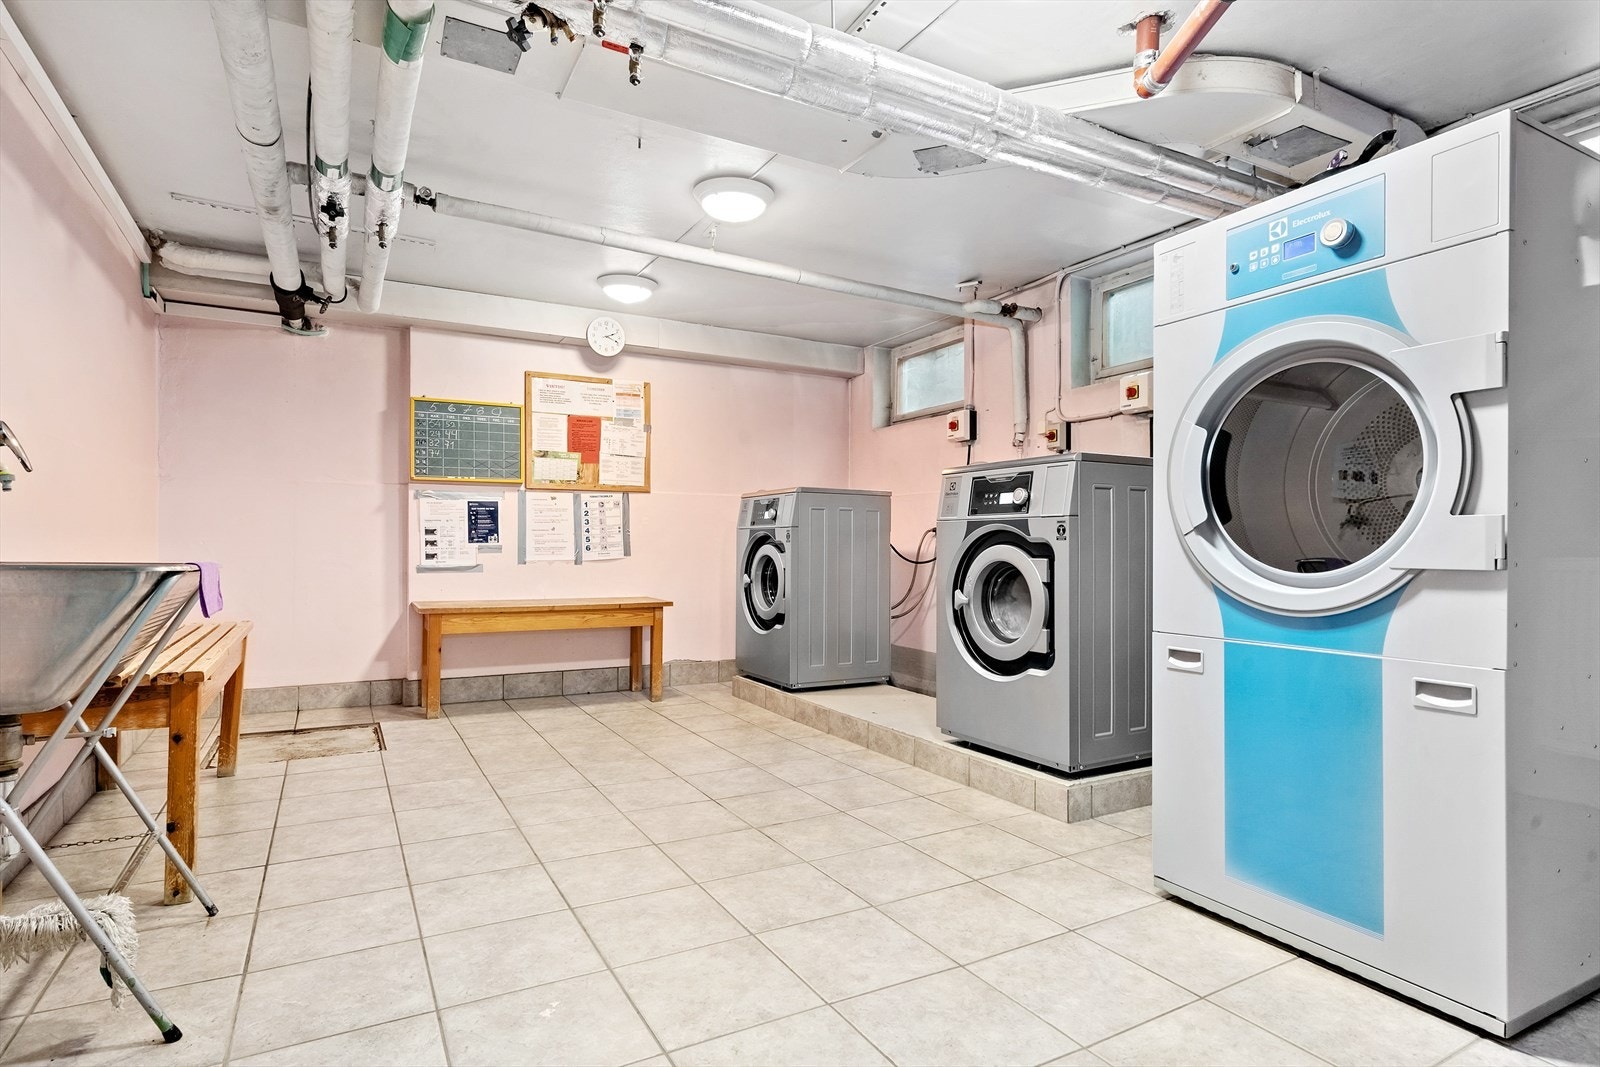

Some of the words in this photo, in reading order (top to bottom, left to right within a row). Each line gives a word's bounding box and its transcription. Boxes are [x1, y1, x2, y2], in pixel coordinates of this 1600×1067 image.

[1292, 210, 1331, 228] Electrolux
[429, 402, 440, 412] 5
[447, 403, 457, 413] 6
[476, 406, 485, 416] 8
[445, 429, 458, 440] 44
[428, 438, 440, 447] 32
[584, 518, 590, 526] 3
[585, 544, 592, 552] 6
